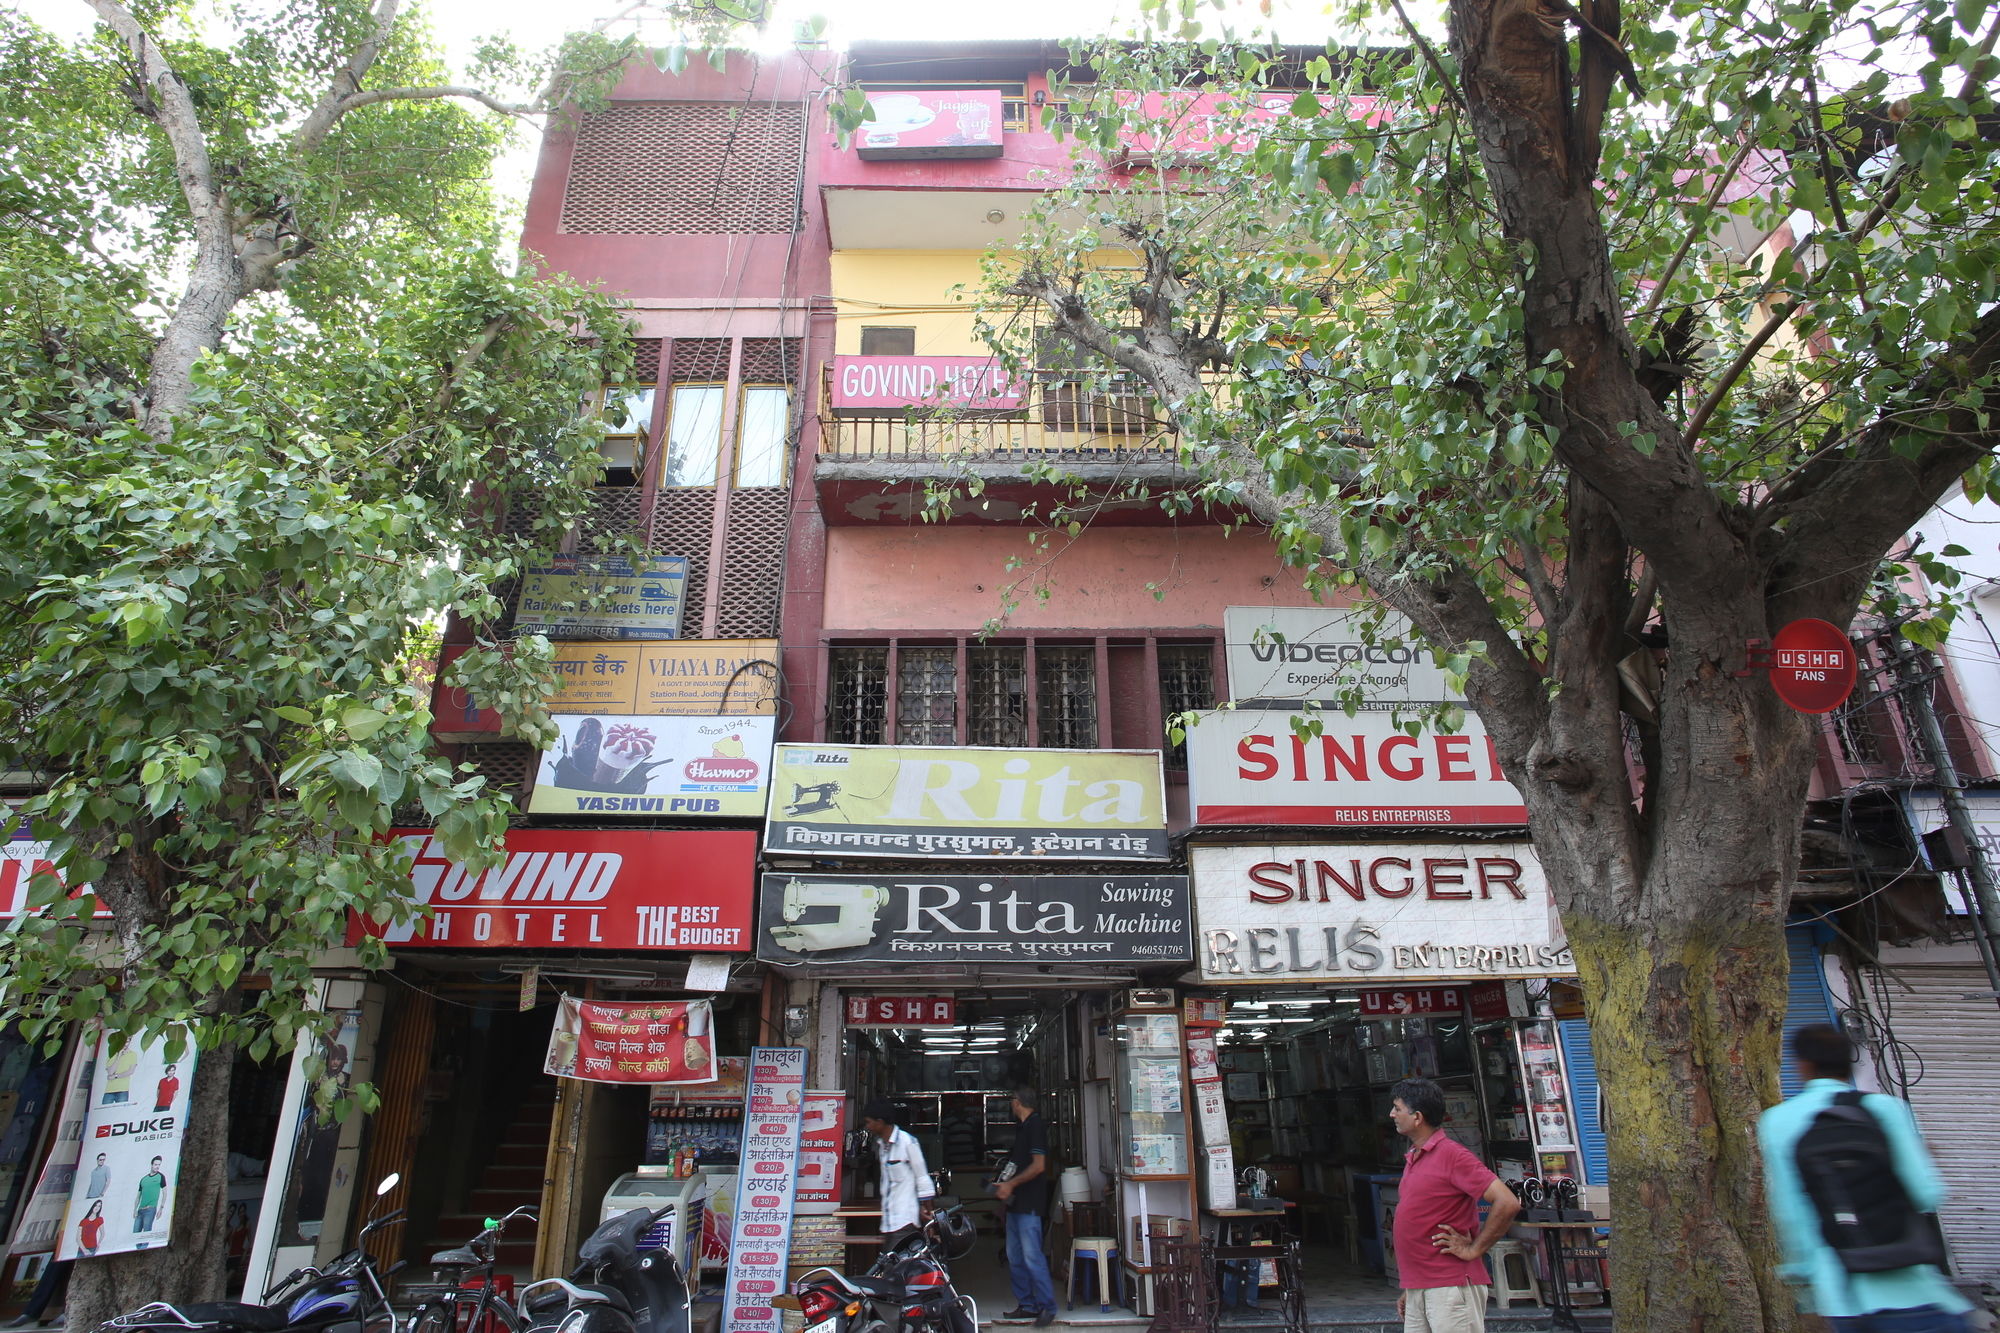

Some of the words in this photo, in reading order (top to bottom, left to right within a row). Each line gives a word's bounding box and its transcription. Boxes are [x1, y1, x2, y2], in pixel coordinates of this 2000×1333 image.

[843, 364, 935, 398] GOVIND
[944, 365, 1020, 398] HOTEL
[645, 601, 674, 616] here
[558, 626, 619, 637] COMPUTERS
[549, 660, 588, 676] जया
[592, 654, 628, 676] बैंक
[647, 658, 709, 677] VIJAYA
[715, 658, 764, 677] BANK
[1781, 653, 1840, 667] USHA
[1287, 672, 1356, 686] Experience
[1360, 673, 1407, 687] Change
[1795, 671, 1826, 682] FANS
[679, 691, 699, 699] Road,
[701, 691, 731, 700] Jodhpr
[698, 726, 724, 735] Since
[814, 754, 848, 764] Rita
[690, 761, 754, 780] Havmor
[875, 758, 1148, 824] Rita
[577, 797, 663, 813] YASHVI
[670, 797, 719, 813] PUB
[1335, 809, 1369, 822] RELIS
[1372, 808, 1451, 822] ENTREPRISES
[786, 826, 912, 847] किशनचन्द
[1031, 831, 1104, 851] स्टेशन
[23, 847, 42, 857] you
[1248, 857, 1527, 905] SINGER
[1101, 883, 1173, 908] Sawing
[893, 883, 1084, 934] Rita
[432, 911, 602, 942] HOTEL
[636, 906, 677, 945] THE
[681, 906, 719, 923] BEST
[1094, 913, 1182, 934] Machine
[680, 927, 741, 945] BUDGET
[1131, 945, 1183, 956] 9460551705
[1204, 927, 1384, 974] RELIS
[1366, 989, 1458, 1010] USHA
[592, 1005, 623, 1021] फालूदा
[853, 1001, 949, 1019] USHA
[620, 1023, 640, 1035] छाछ
[594, 1040, 615, 1053] बादाम
[619, 1038, 644, 1054] मिल्क
[647, 1038, 666, 1054] शेक
[585, 1056, 611, 1073] कुल्फी
[618, 1057, 643, 1073] कोल्ड
[646, 1056, 670, 1073] कॉफी
[758, 1050, 802, 1068] फालूदा
[111, 1117, 174, 1137] DUKE
[134, 1131, 173, 1142] BASICS
